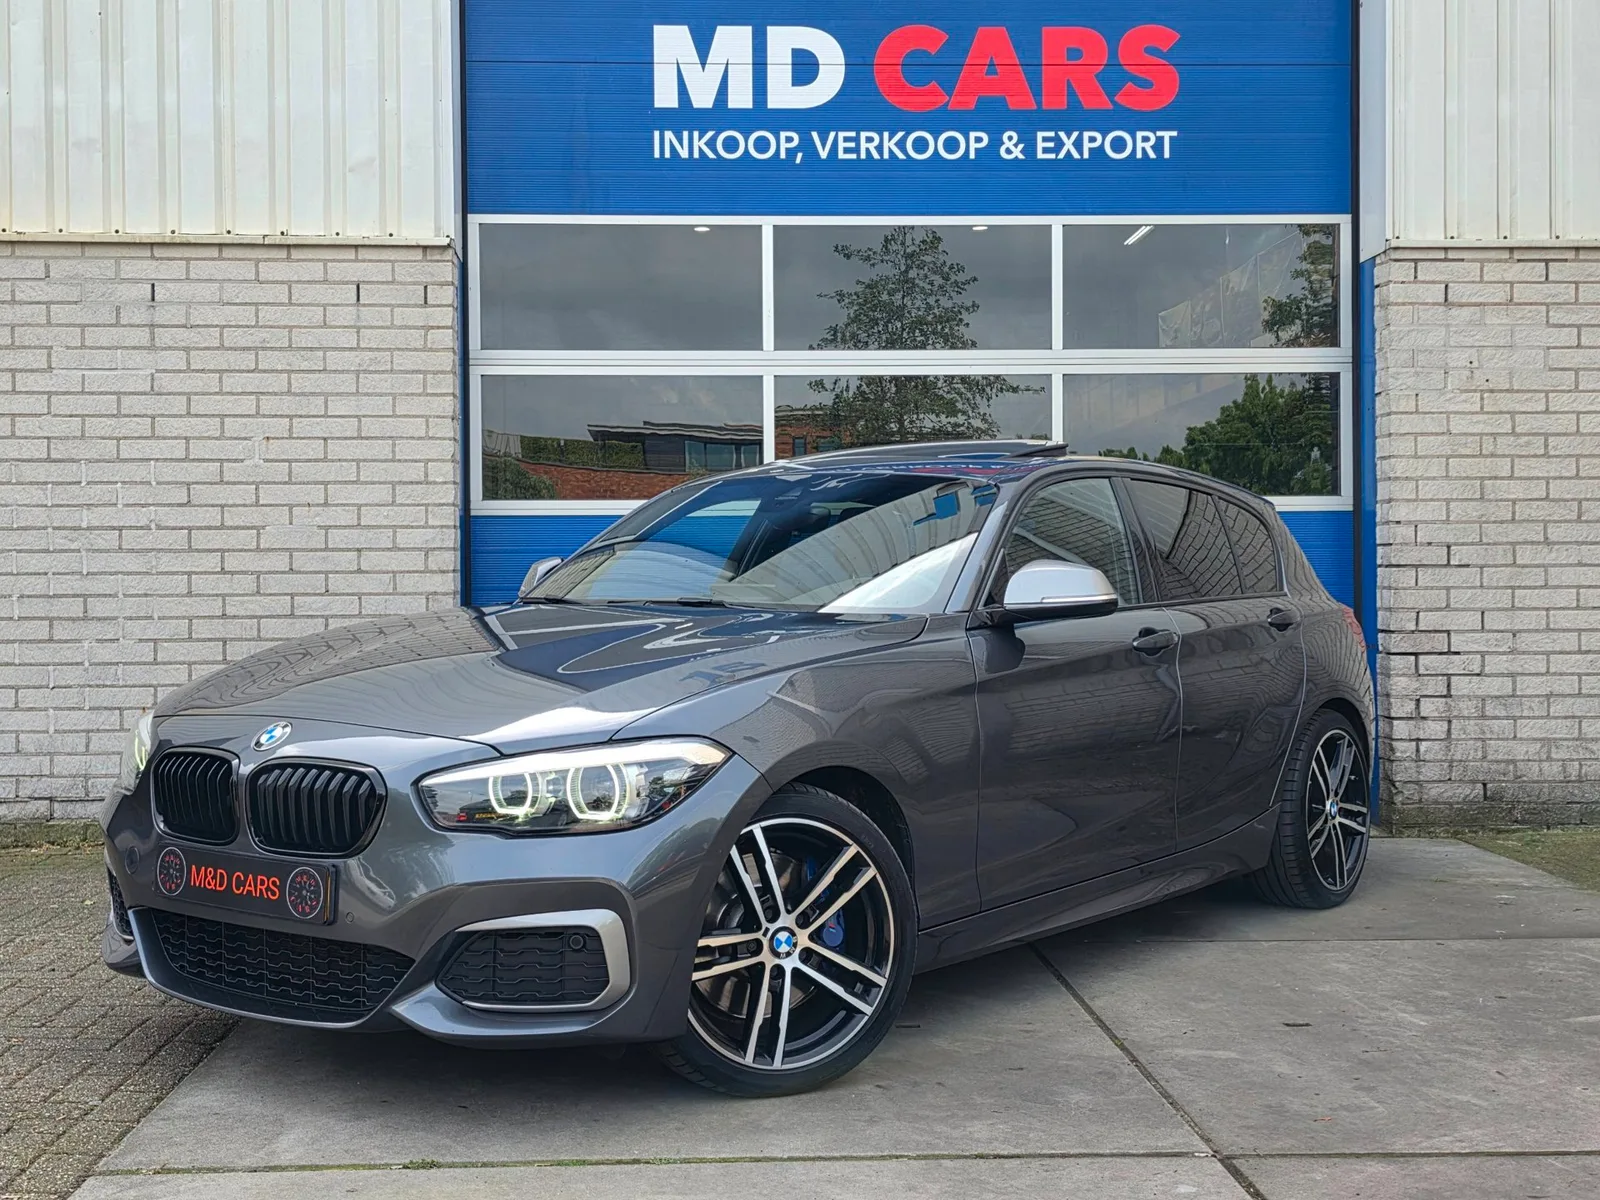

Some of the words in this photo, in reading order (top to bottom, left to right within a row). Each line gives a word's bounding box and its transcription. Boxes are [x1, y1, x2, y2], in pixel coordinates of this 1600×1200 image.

[653, 25, 846, 109] MD
[874, 24, 1181, 112] CARS
[653, 130, 803, 164] INKOOP,
[811, 130, 989, 160] VERKOOP
[999, 130, 1026, 160] &
[1036, 130, 1178, 160] EXPORT
[190, 864, 228, 891] M&D
[231, 871, 280, 900] CARS
